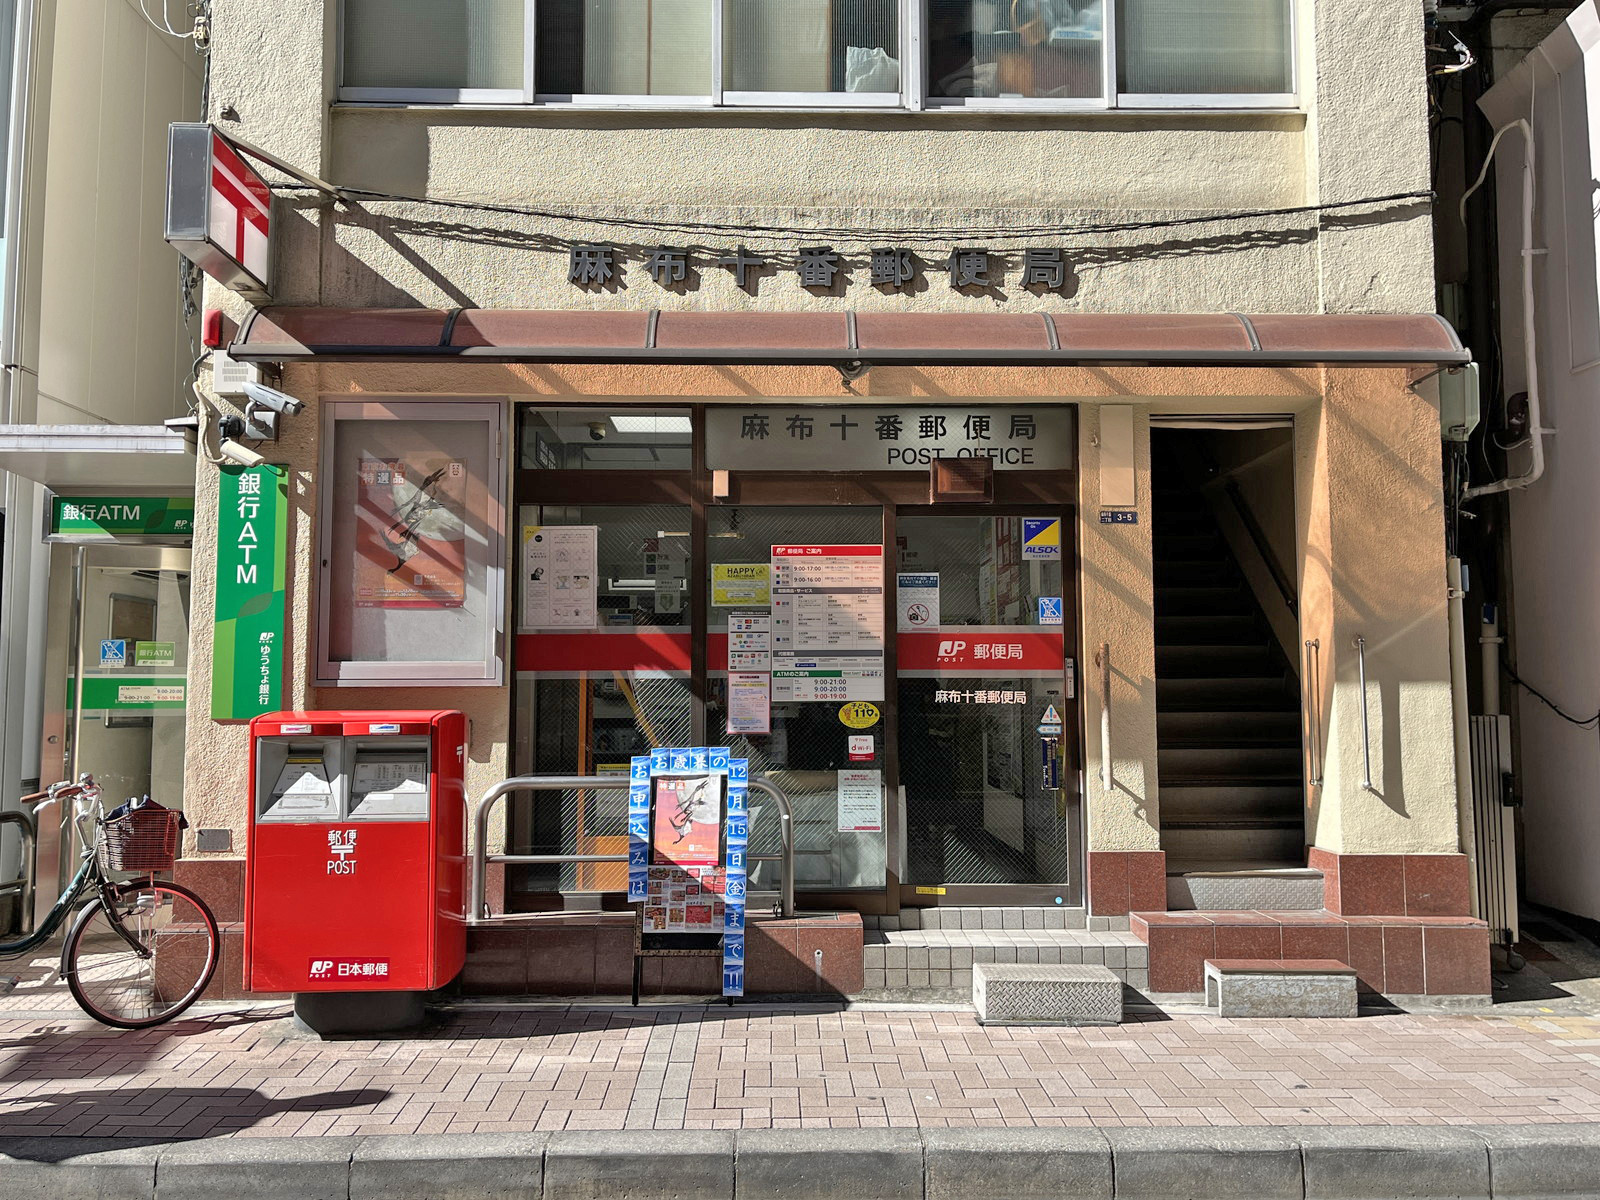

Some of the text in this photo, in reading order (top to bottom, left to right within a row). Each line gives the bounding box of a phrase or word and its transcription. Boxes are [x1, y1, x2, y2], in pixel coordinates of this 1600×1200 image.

[567, 245, 1066, 289] 麻布十番郵便局
[741, 414, 1038, 441] 麻布十番郵便局
[888, 448, 1034, 464] POST OFFICE
[363, 473, 404, 483] 特選品
[63, 504, 140, 520] 銀行ATM
[236, 473, 260, 584] 銀行ATM
[260, 632, 274, 641] JP
[938, 641, 966, 657] JP
[974, 643, 1024, 660] 郵便局
[259, 645, 271, 704] ゆうちょ銀行
[935, 690, 1027, 705] 麻布十番郵便局
[655, 754, 727, 770] お歳暮の
[328, 829, 357, 846] 郵便
[631, 764, 648, 895] お申込みは
[327, 860, 357, 874] POST
[311, 961, 333, 974] JP
[338, 962, 388, 976] 日本郵便
